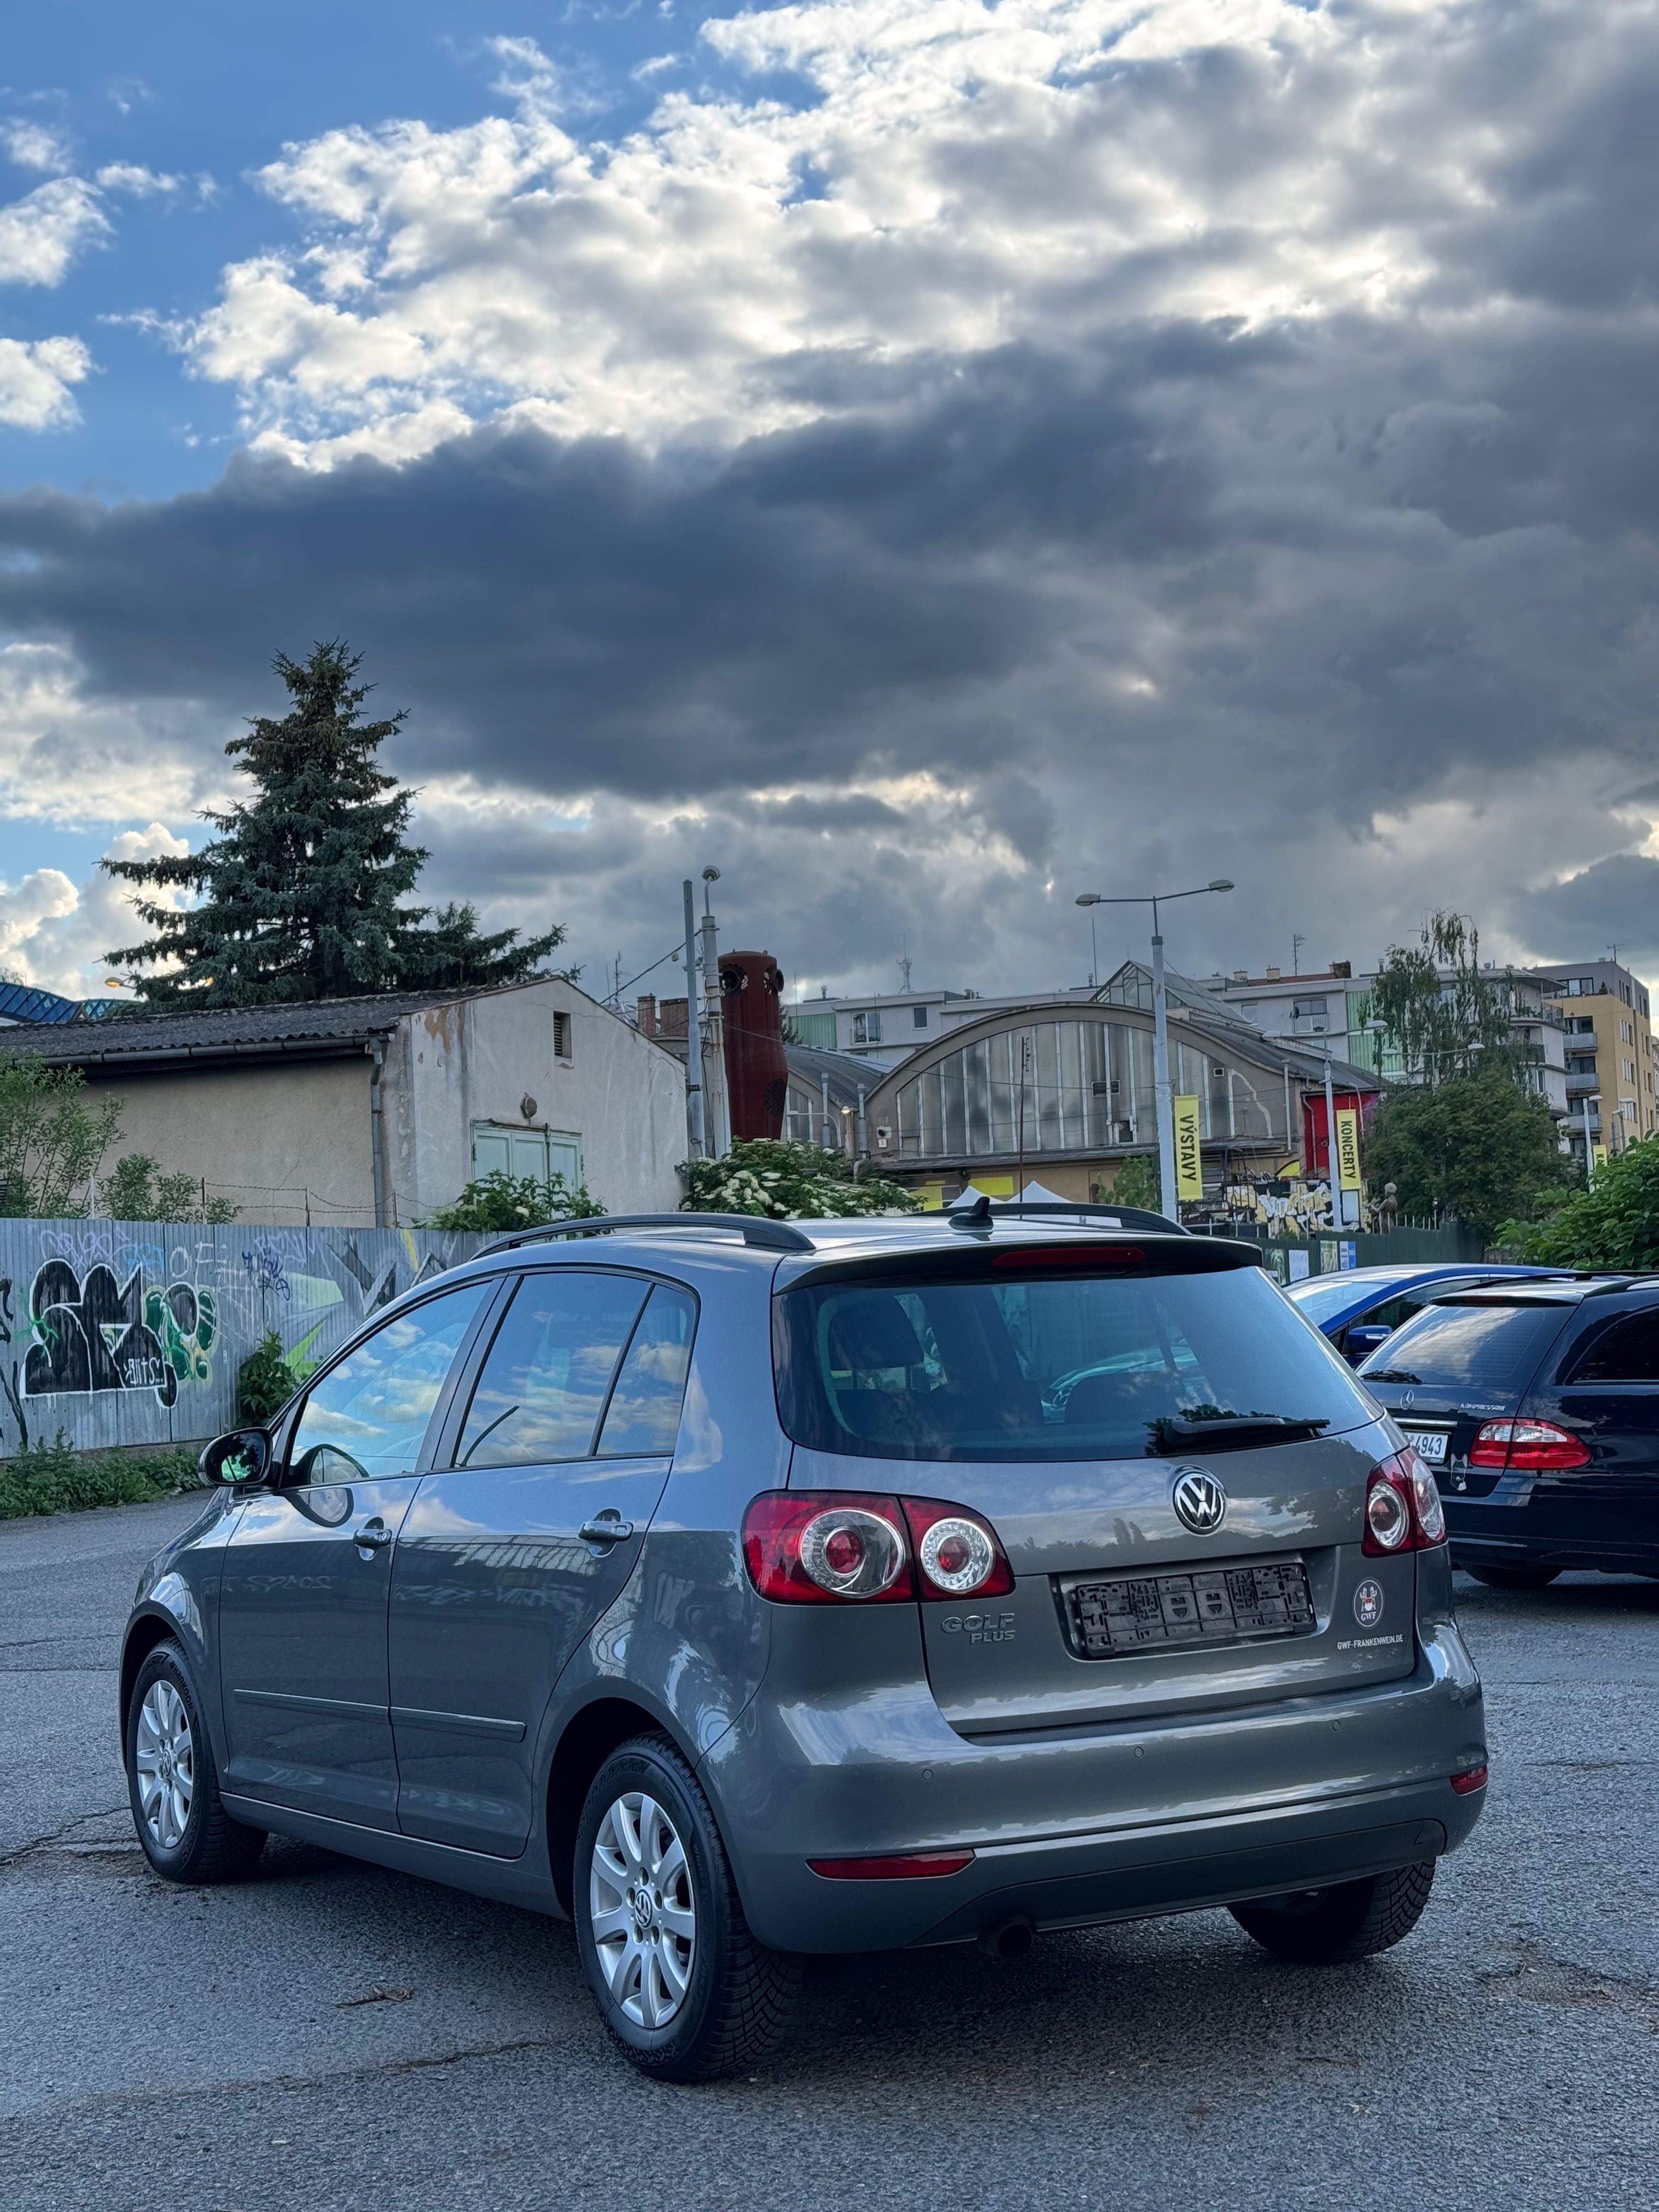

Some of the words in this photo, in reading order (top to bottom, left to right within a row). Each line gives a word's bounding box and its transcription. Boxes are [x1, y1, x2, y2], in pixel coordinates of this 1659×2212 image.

[1180, 1114, 1197, 1181] VÝSTAVY
[1341, 1120, 1356, 1178] KONCERTY
[942, 1613, 1015, 1633] GOLF
[1361, 1611, 1377, 1621] GWF
[970, 1629, 1016, 1644] PLUS
[1337, 1634, 1404, 1650] GWF-FRANKENWEIN.DE
